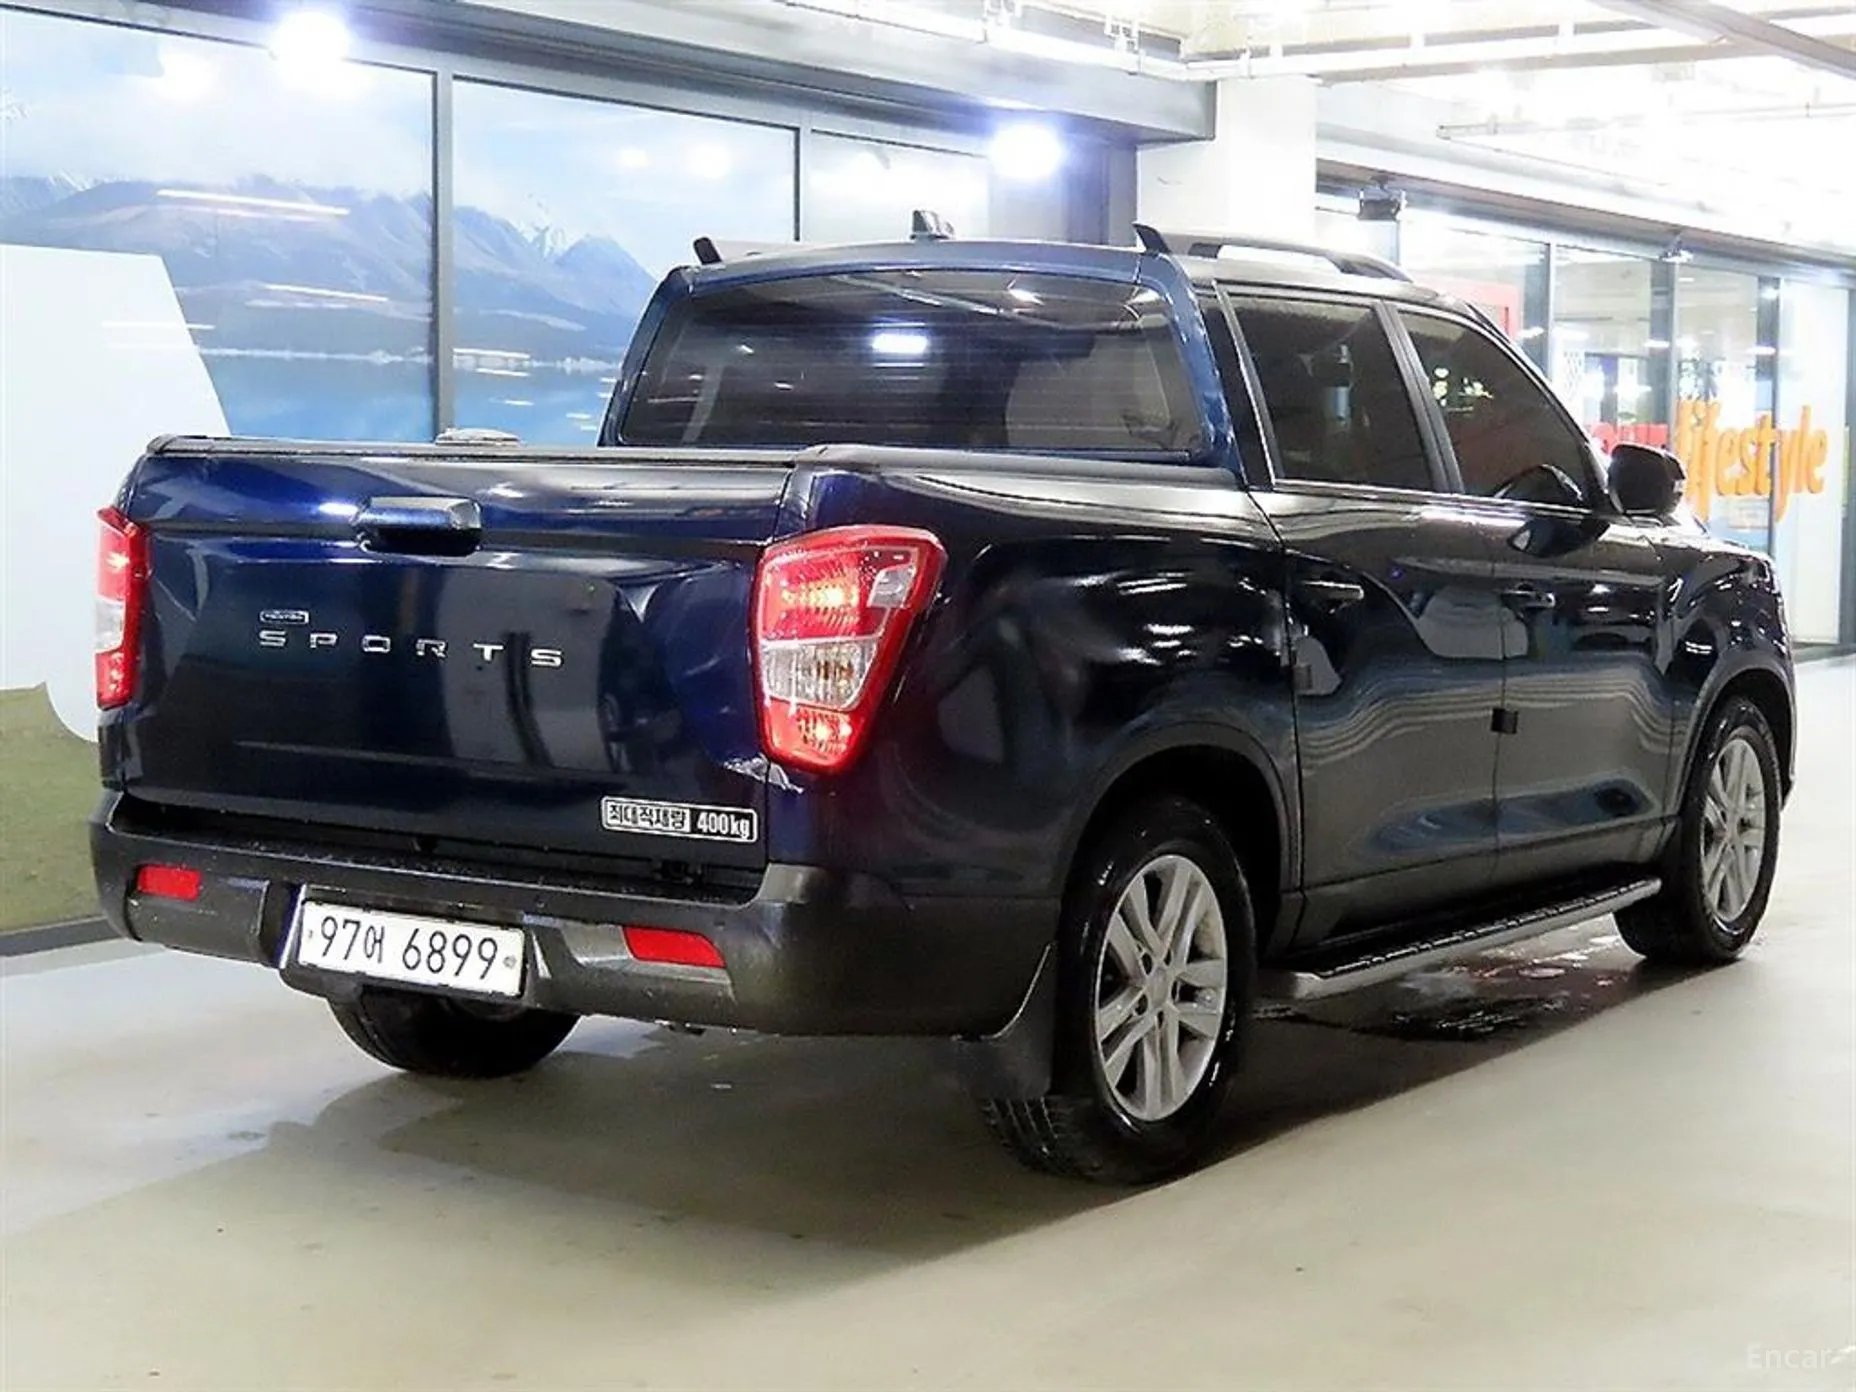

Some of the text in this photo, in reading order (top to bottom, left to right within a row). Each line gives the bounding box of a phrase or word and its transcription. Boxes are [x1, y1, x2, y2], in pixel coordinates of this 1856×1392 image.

[1674, 398, 1828, 522] lifestyle
[258, 630, 563, 668] SPORTS
[608, 802, 751, 839] 최대적재량 400kg
[320, 915, 499, 981] 97어 6899
